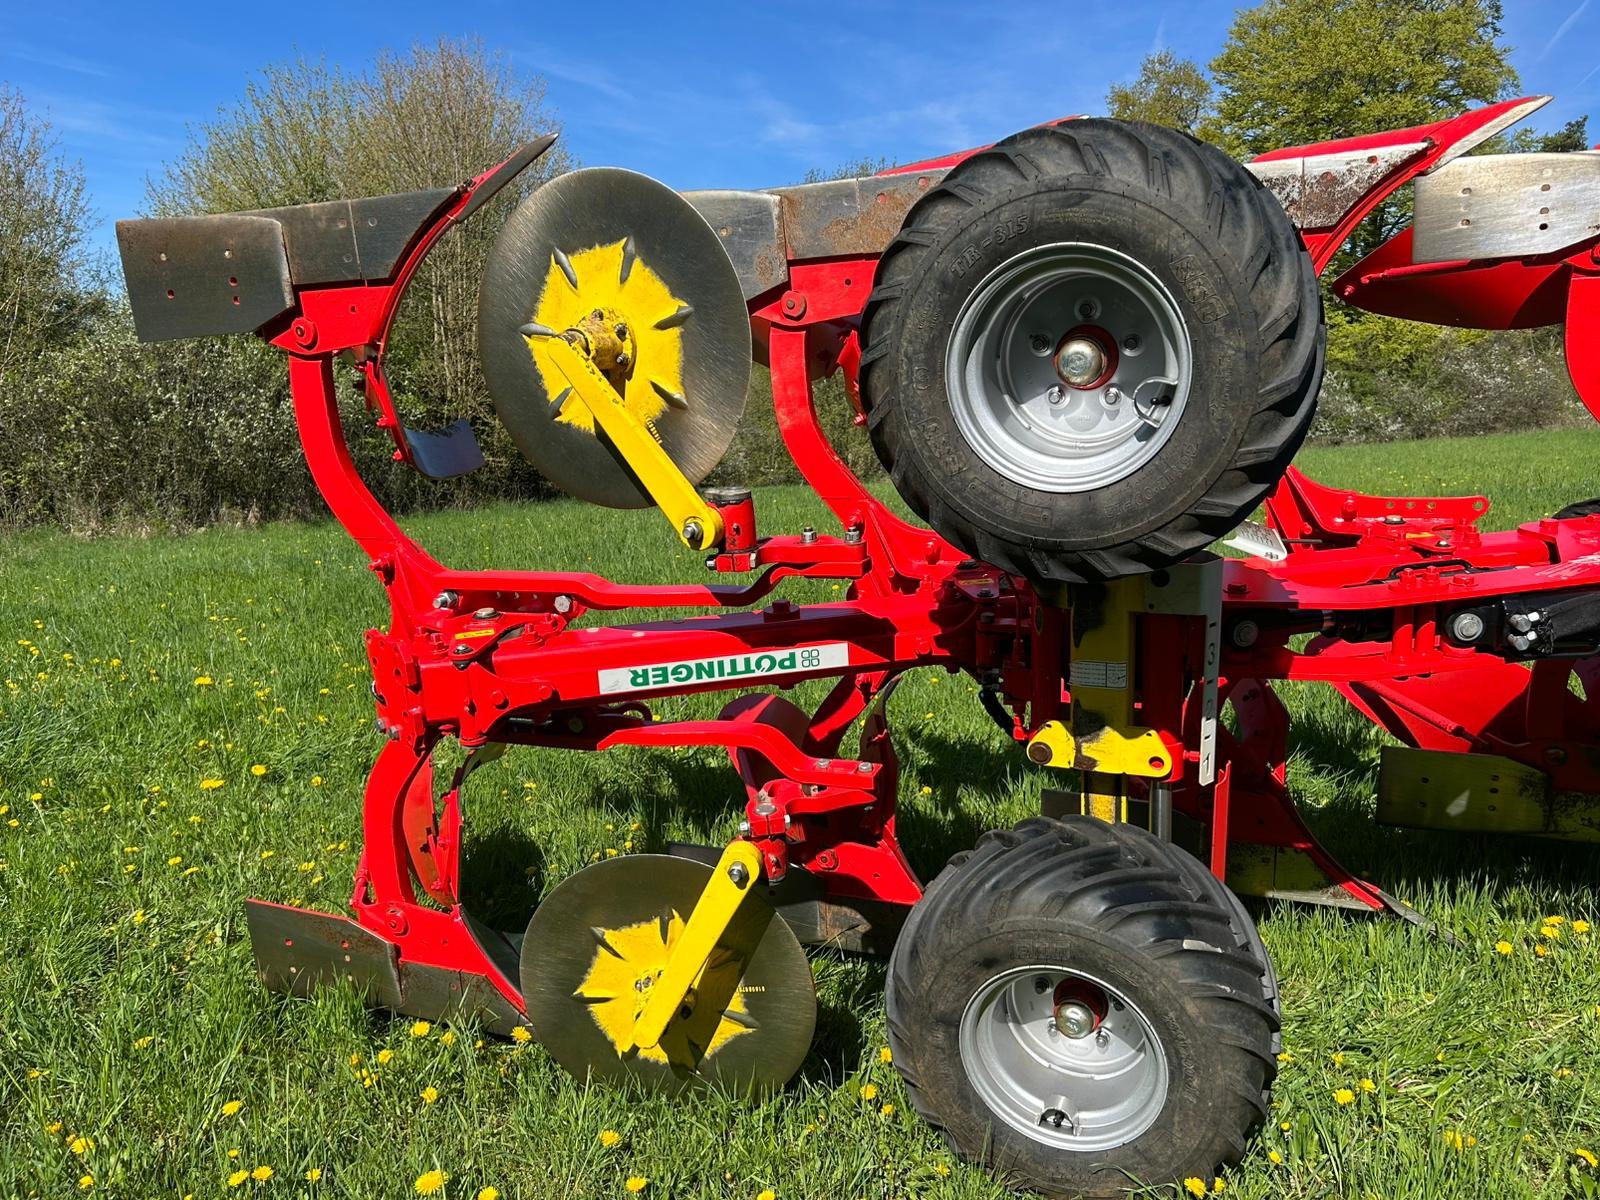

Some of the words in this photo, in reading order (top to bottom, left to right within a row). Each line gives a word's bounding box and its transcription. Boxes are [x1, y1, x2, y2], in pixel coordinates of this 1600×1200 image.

[949, 214, 1031, 279] TR-315
[1206, 642, 1217, 666] 3
[629, 651, 797, 688] PÖTTINGER
[1202, 752, 1212, 776] 1
